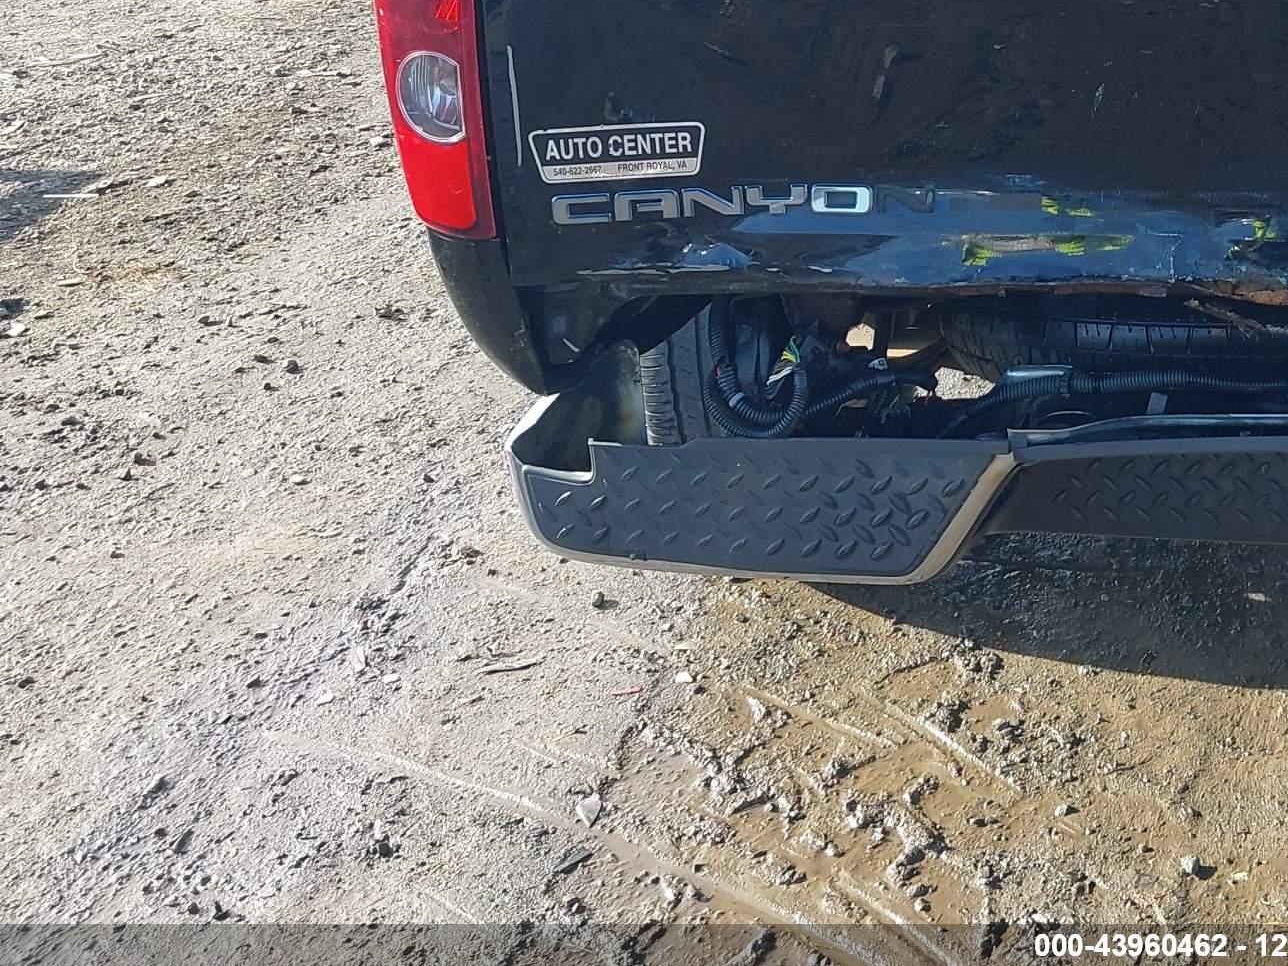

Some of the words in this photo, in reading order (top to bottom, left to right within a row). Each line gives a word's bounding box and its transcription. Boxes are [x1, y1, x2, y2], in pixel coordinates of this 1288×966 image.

[545, 137, 602, 161] AUTO
[608, 132, 692, 156] CENTER
[617, 161, 645, 173] FRONT
[646, 160, 675, 171] ROYAL,
[676, 159, 688, 170] VA
